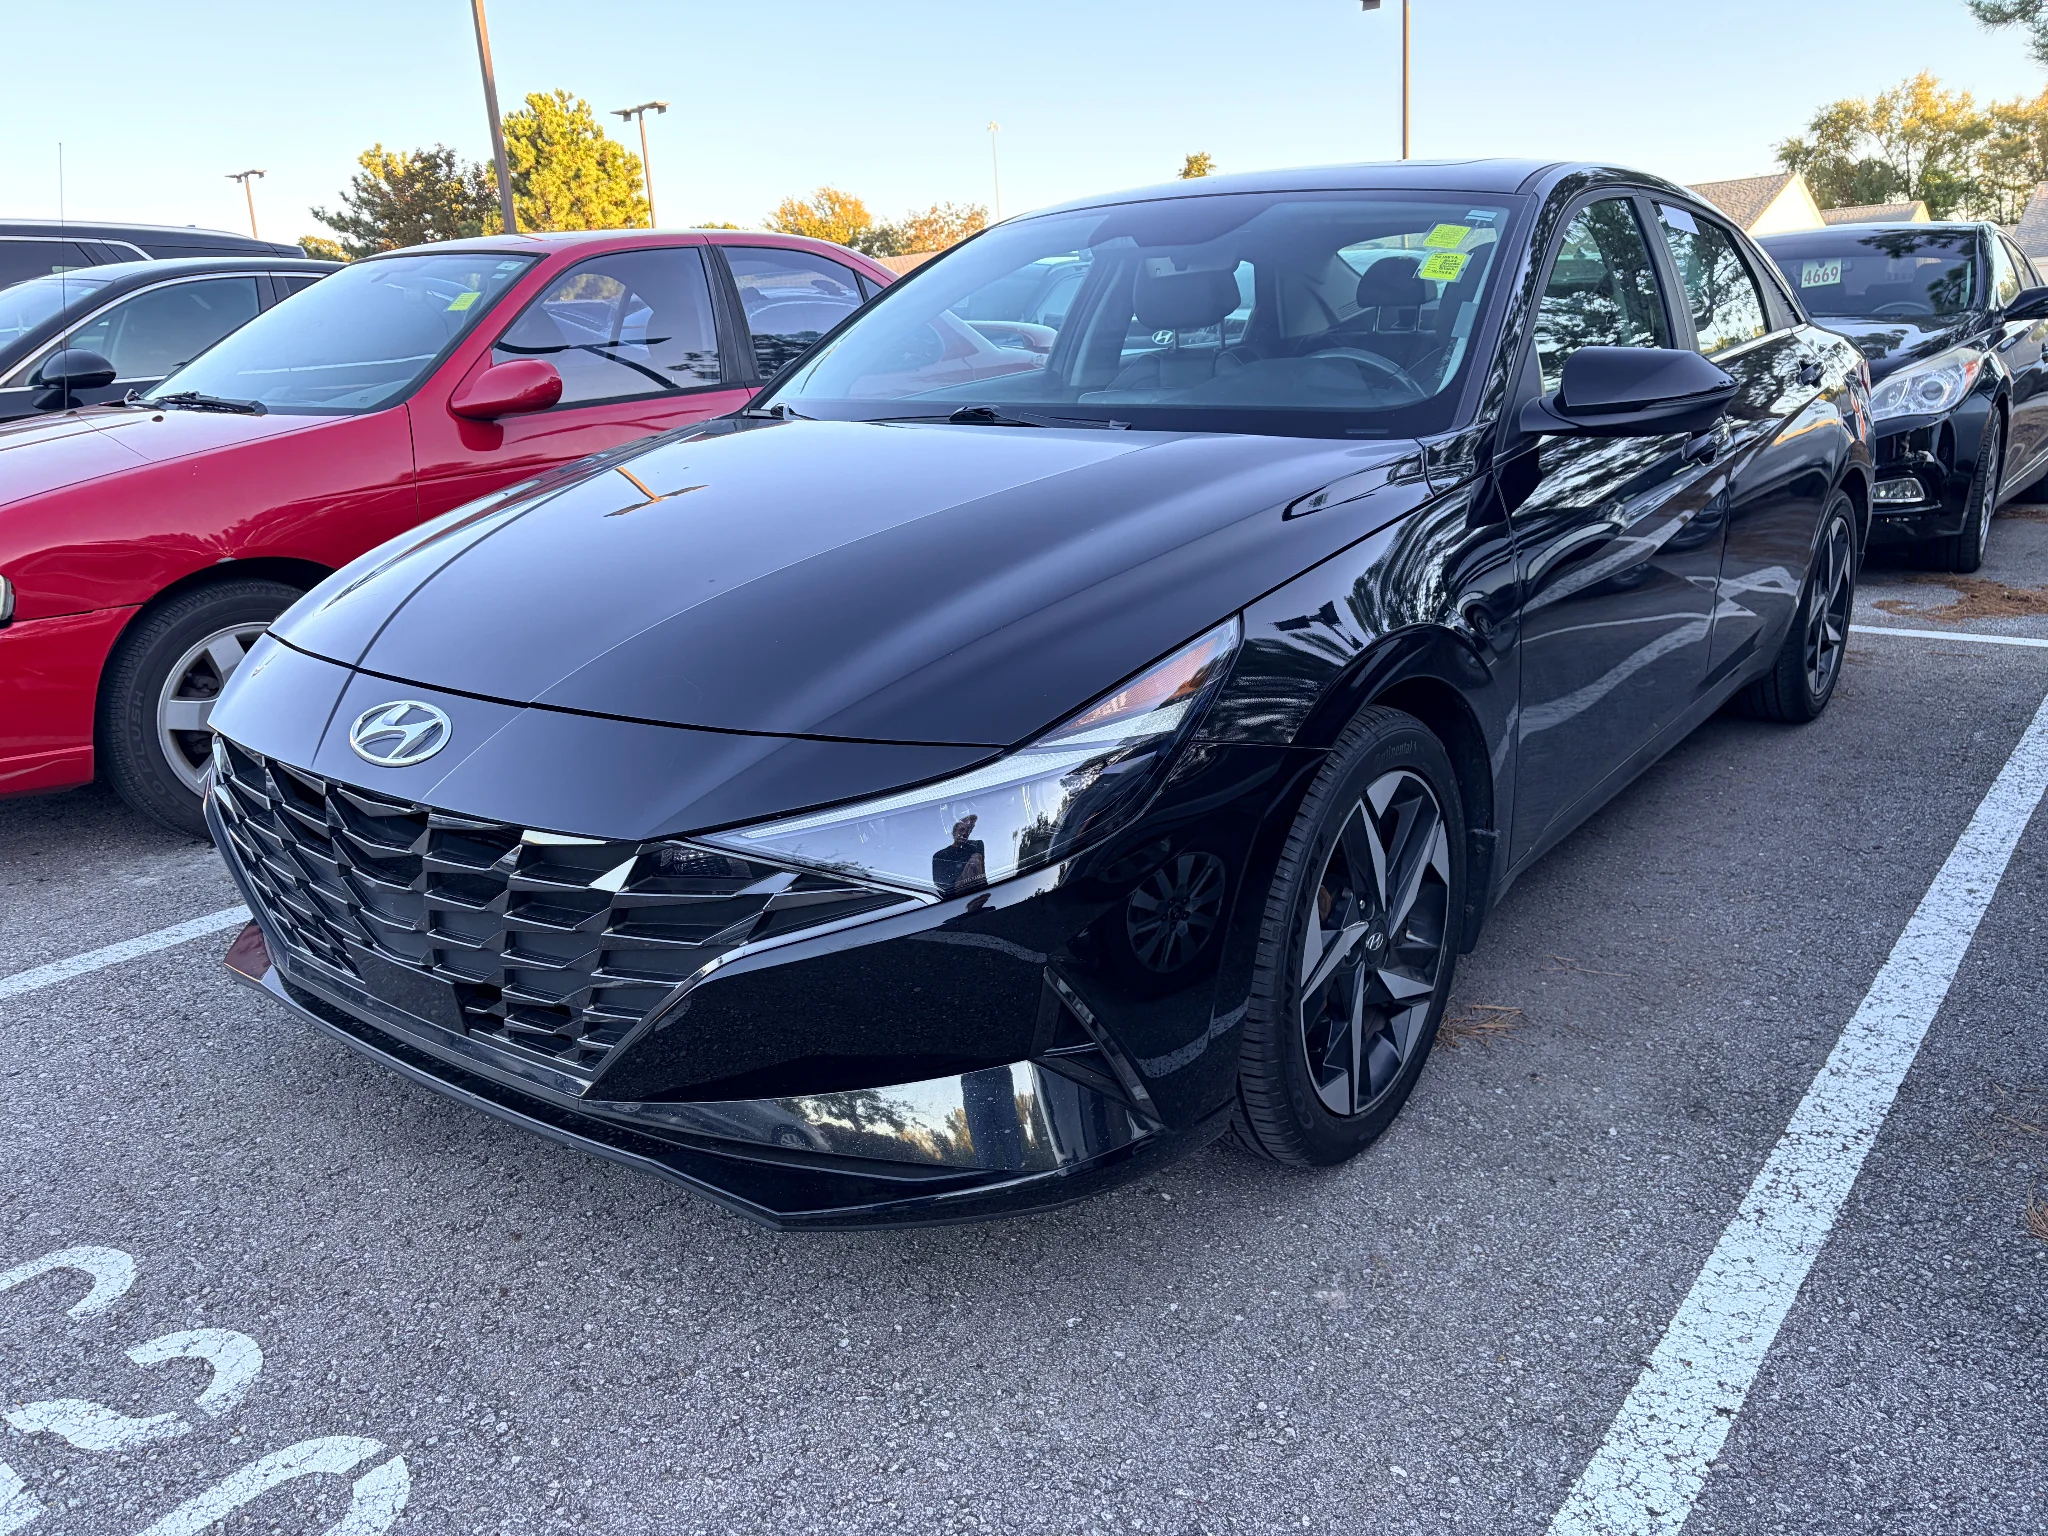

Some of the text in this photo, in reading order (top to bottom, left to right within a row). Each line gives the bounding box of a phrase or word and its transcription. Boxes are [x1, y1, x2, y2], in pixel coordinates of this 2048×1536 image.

[1804, 266, 1839, 284] 4669
[129, 691, 154, 774] PLUSH
[1373, 740, 1414, 772] Continental
